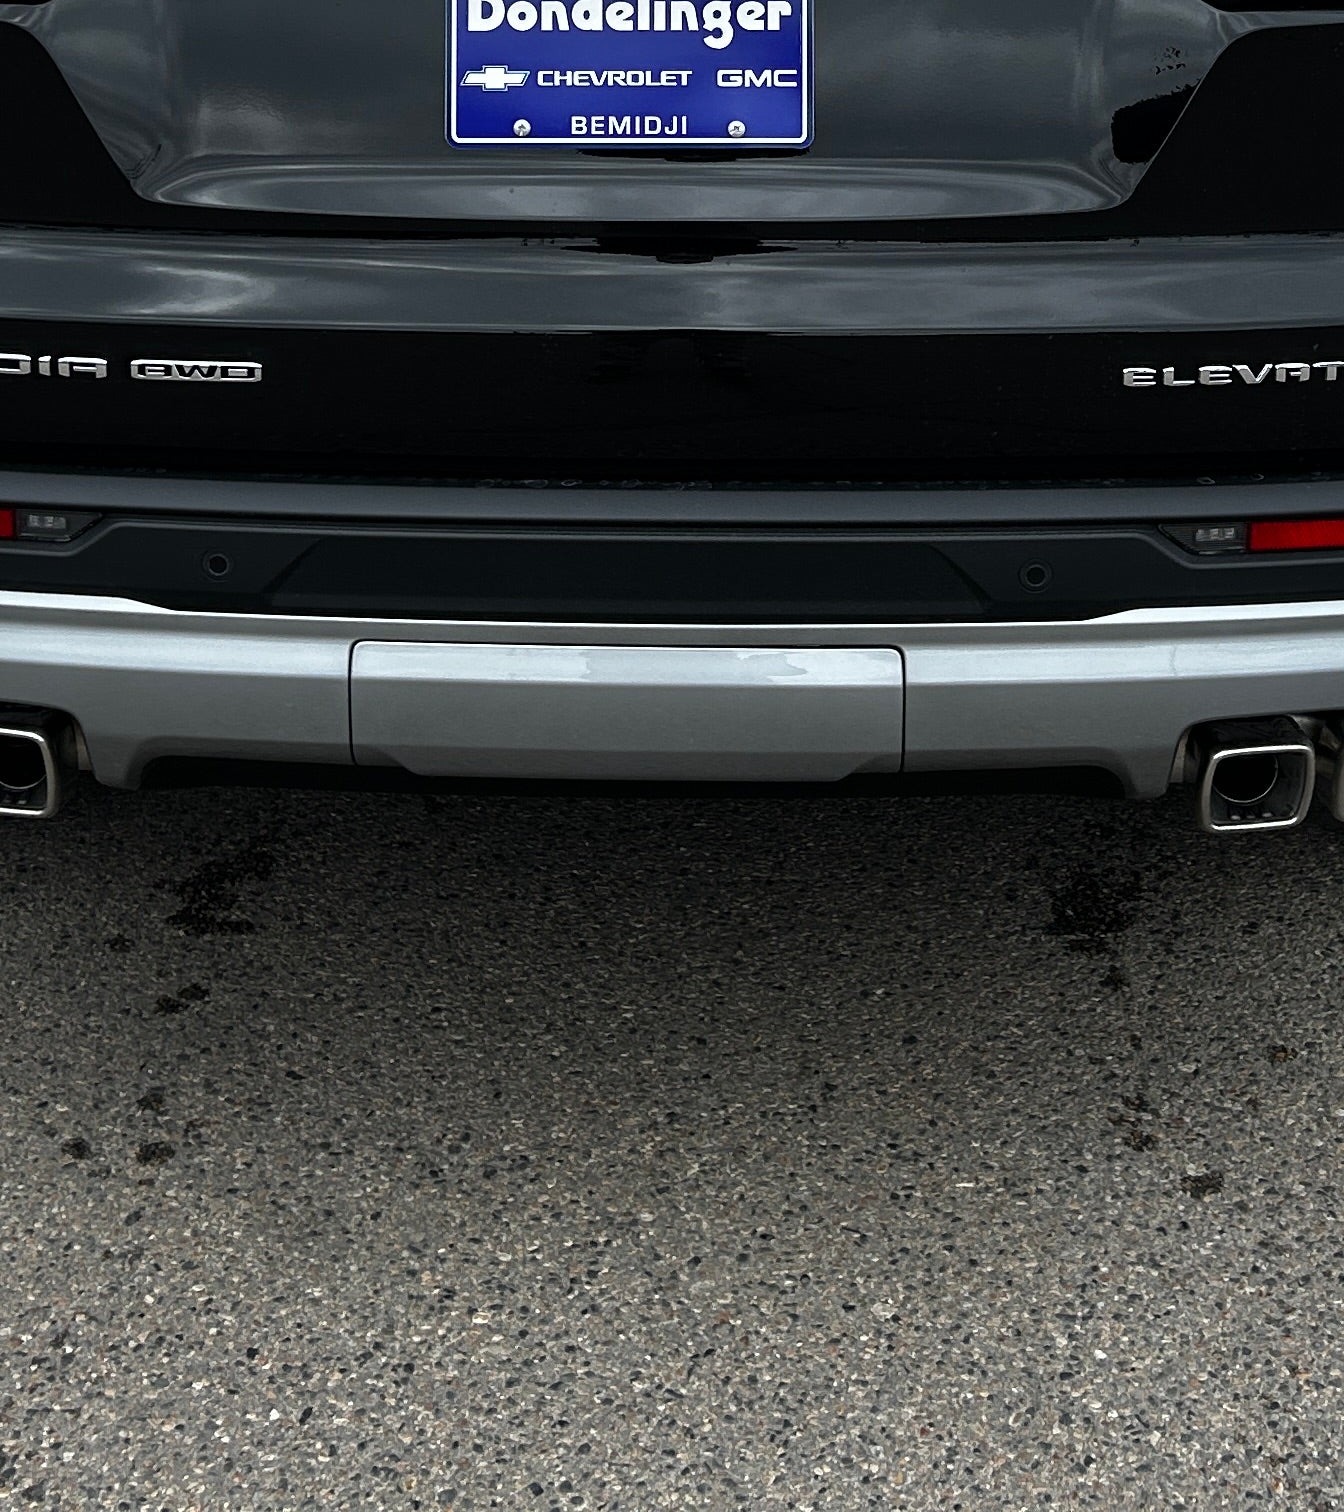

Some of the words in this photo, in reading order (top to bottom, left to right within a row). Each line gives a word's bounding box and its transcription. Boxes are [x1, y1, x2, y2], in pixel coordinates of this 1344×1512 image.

[537, 70, 693, 87] CHEVROLET
[716, 69, 798, 88] GMC
[571, 115, 687, 135] BEMIDJI
